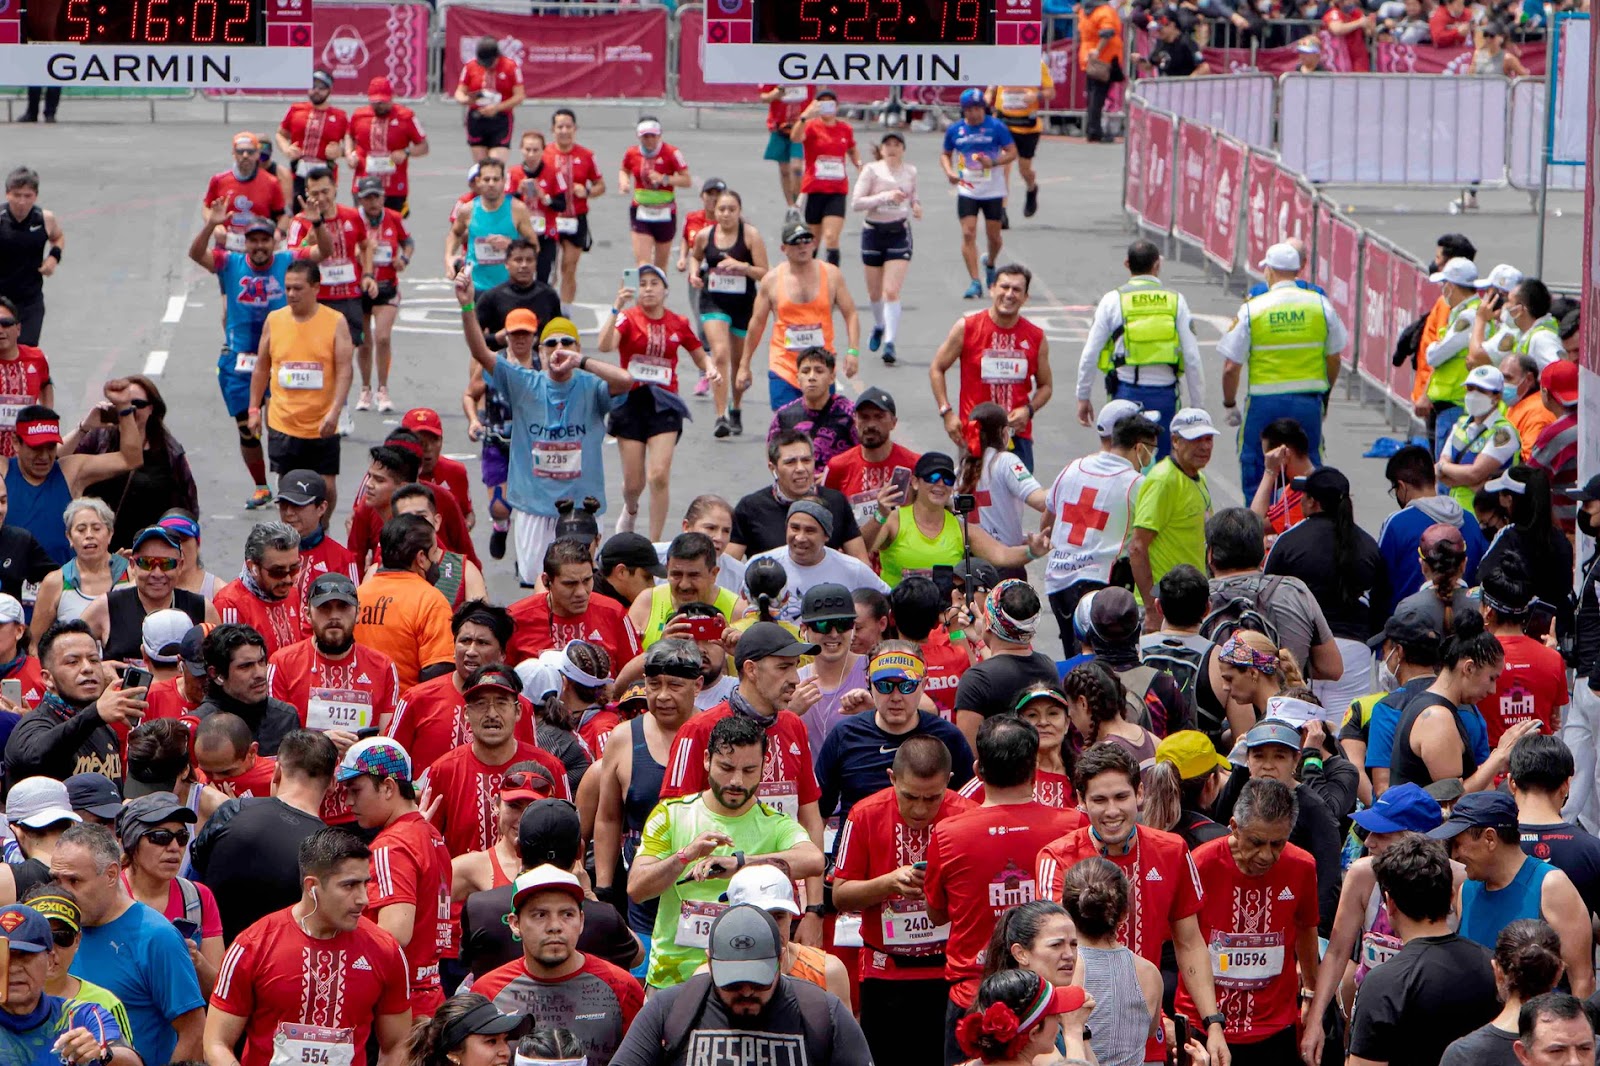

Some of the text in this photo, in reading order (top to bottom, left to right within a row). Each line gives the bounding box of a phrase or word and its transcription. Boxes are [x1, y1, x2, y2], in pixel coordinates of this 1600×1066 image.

[47, 53, 230, 82] GARMIN
[778, 52, 960, 81] GARMIN
[1132, 294, 1167, 303] ERUM
[1270, 311, 1304, 323] ERUM
[546, 455, 567, 464] 2285
[878, 657, 914, 667] VENEZUELA
[329, 707, 357, 720] 9112
[766, 802, 782, 813] 18
[909, 931, 933, 939] FERNANDO
[1228, 952, 1267, 966] 10596
[301, 1048, 329, 1065] 554
[695, 1036, 799, 1066] RESPECT
